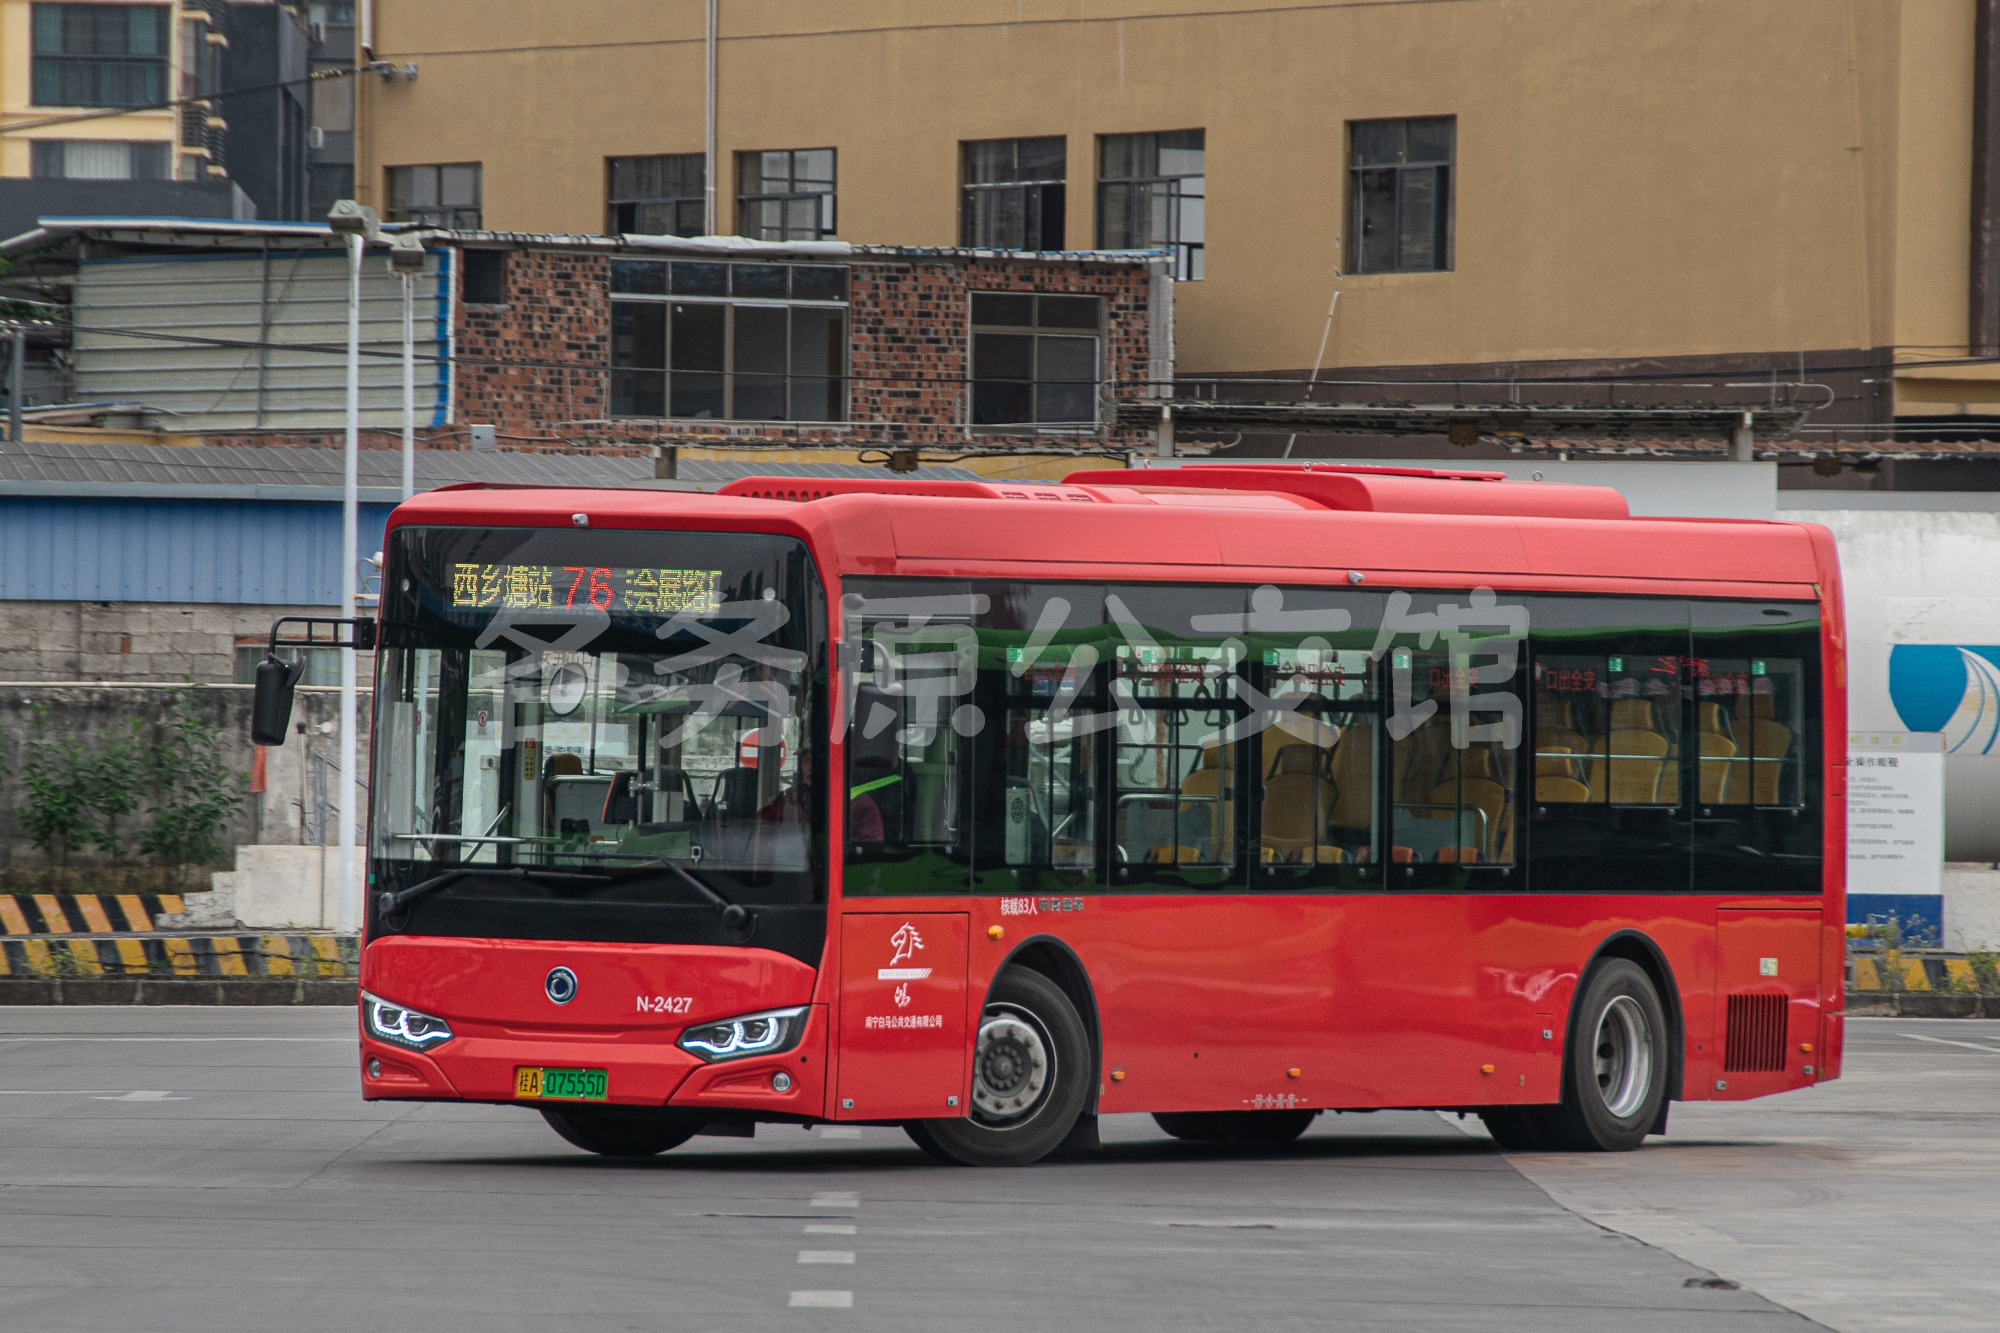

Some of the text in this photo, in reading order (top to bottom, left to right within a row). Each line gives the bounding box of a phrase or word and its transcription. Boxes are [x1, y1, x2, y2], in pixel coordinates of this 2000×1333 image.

[452, 563, 554, 609] 西乡塘站
[562, 567, 614, 611] 76
[1000, 896, 1038, 916] 核载83人
[636, 996, 694, 1015] N-2427
[865, 1015, 943, 1031] 南宁白马公共交通有限公司
